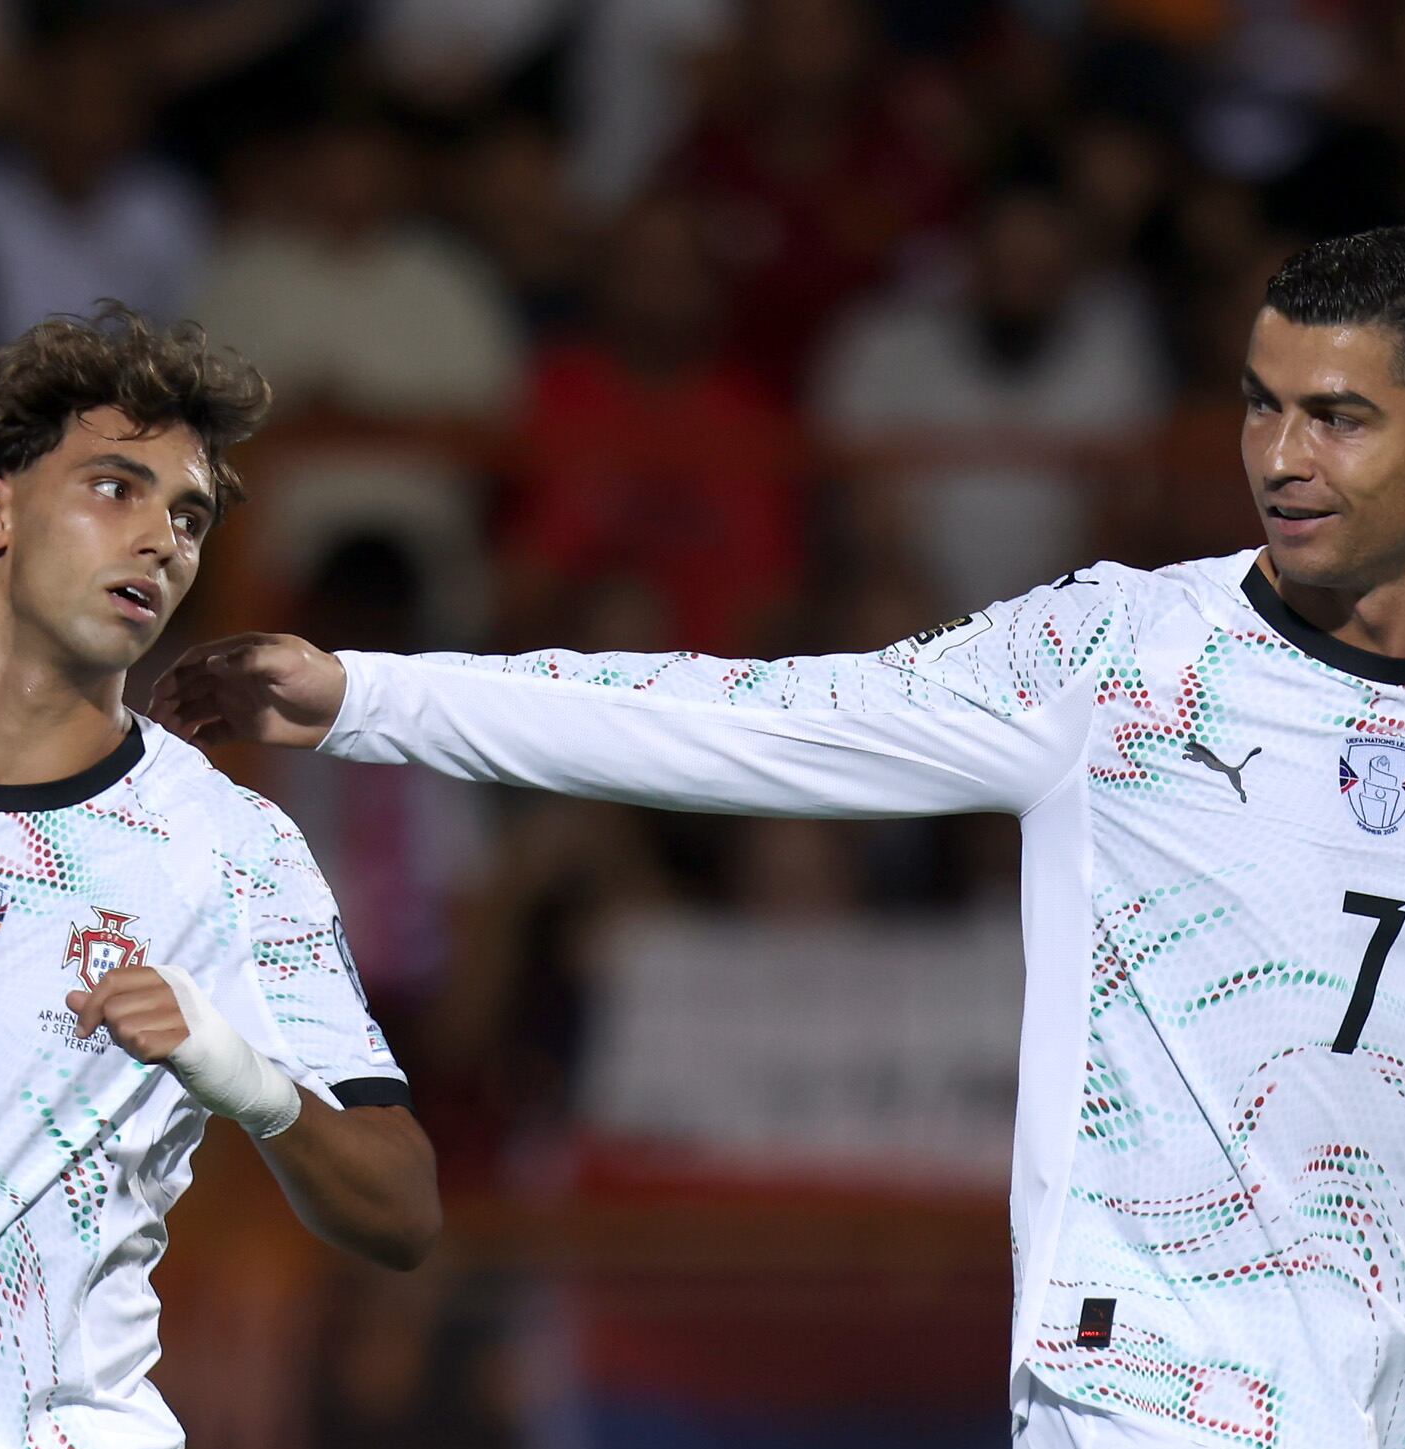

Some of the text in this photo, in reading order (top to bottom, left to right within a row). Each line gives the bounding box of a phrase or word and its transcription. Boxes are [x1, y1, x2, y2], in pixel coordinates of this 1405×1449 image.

[1365, 737, 1395, 746] NATIONS
[41, 1024, 48, 1032] 6
[64, 1036, 107, 1055] YEREVAN
